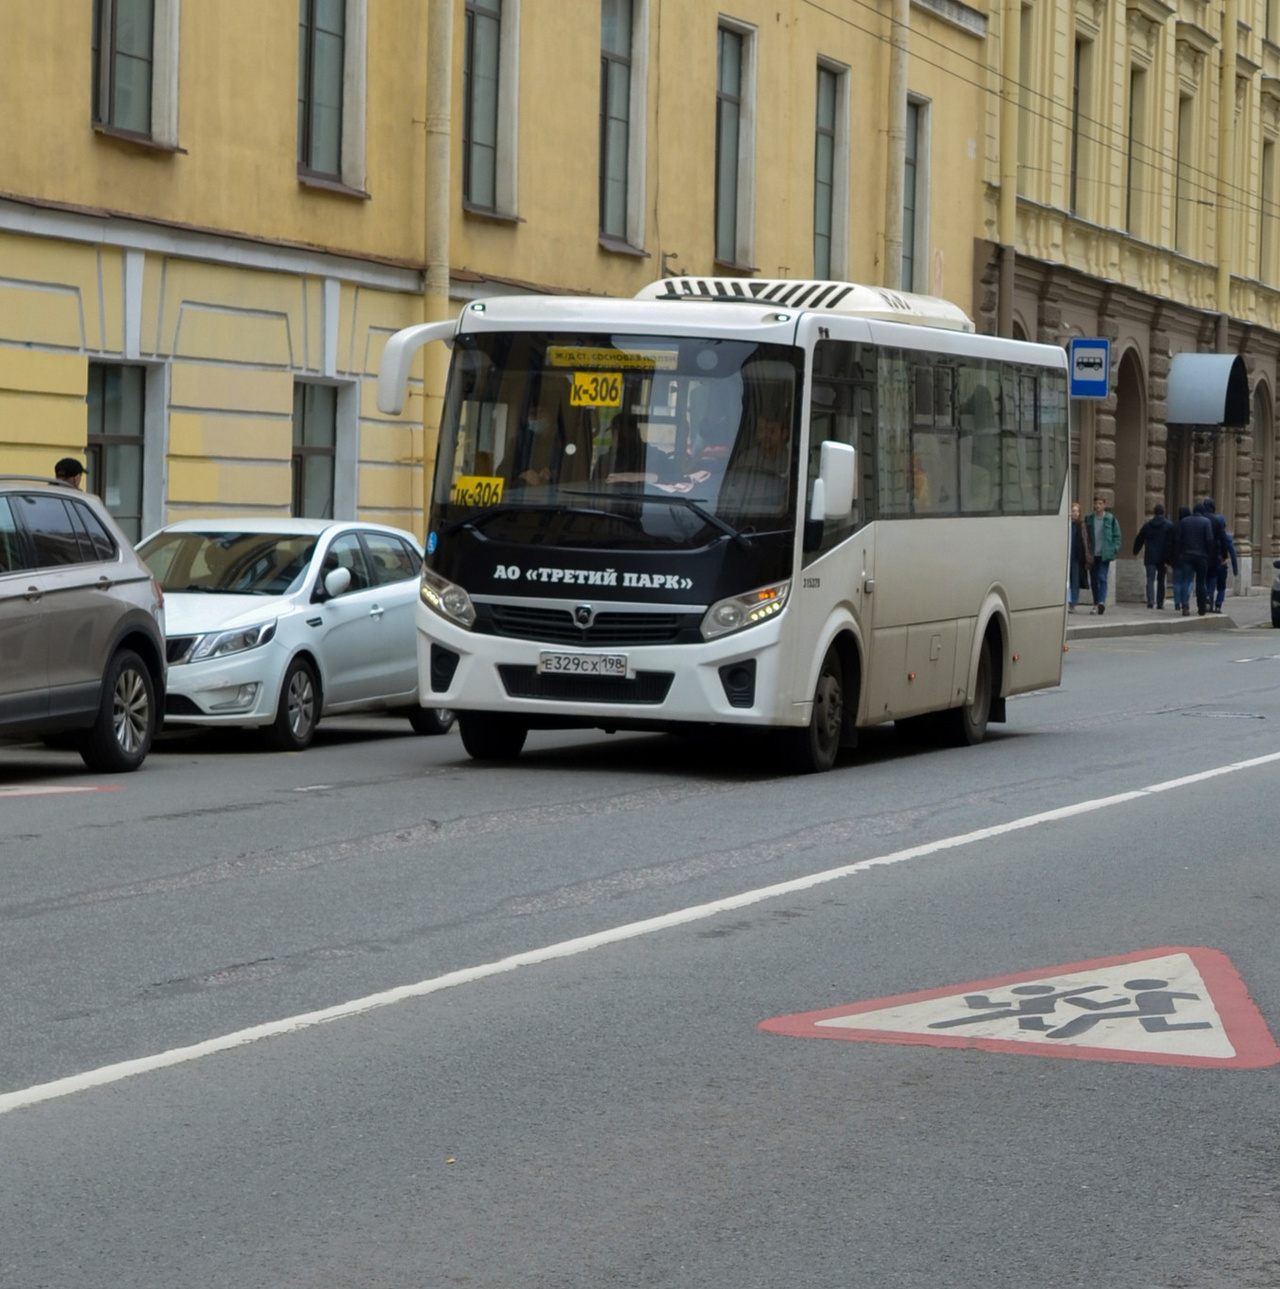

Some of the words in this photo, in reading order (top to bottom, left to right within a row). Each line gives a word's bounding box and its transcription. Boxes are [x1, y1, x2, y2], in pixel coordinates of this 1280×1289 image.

[494, 565, 520, 580] АО
[526, 568, 618, 586] «ТРЕТИЙ
[623, 572, 693, 589] ПАРК»
